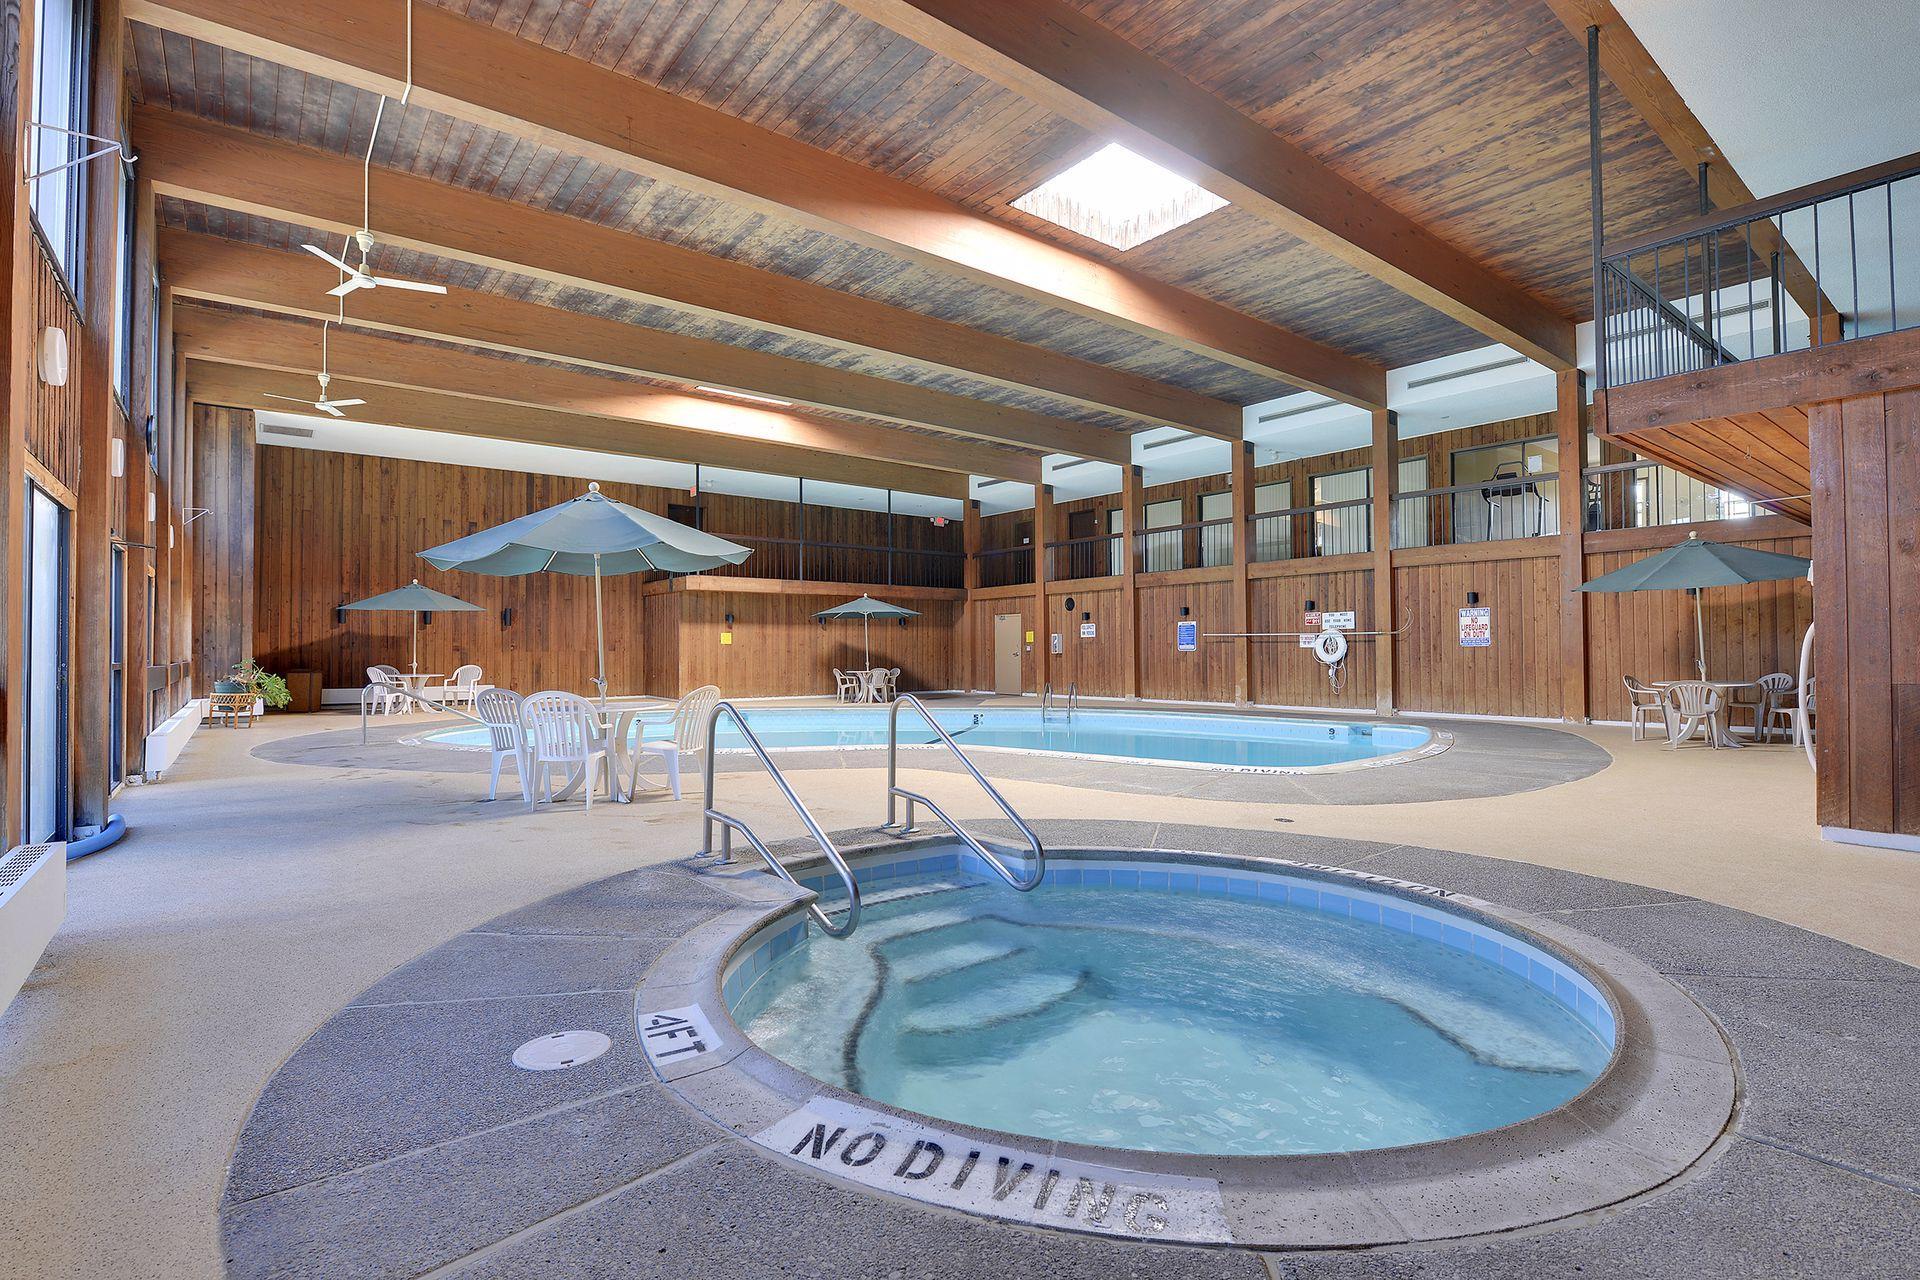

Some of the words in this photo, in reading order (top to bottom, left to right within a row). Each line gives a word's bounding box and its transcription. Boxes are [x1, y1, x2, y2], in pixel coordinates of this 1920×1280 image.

[1460, 609, 1489, 617] WARNING
[1460, 623, 1489, 631] LIFEGUARD
[1472, 630, 1486, 638] DUTY
[1240, 767, 1304, 776] DIVING
[789, 1123, 887, 1168] NO
[893, 1139, 1170, 1235] DIVING
